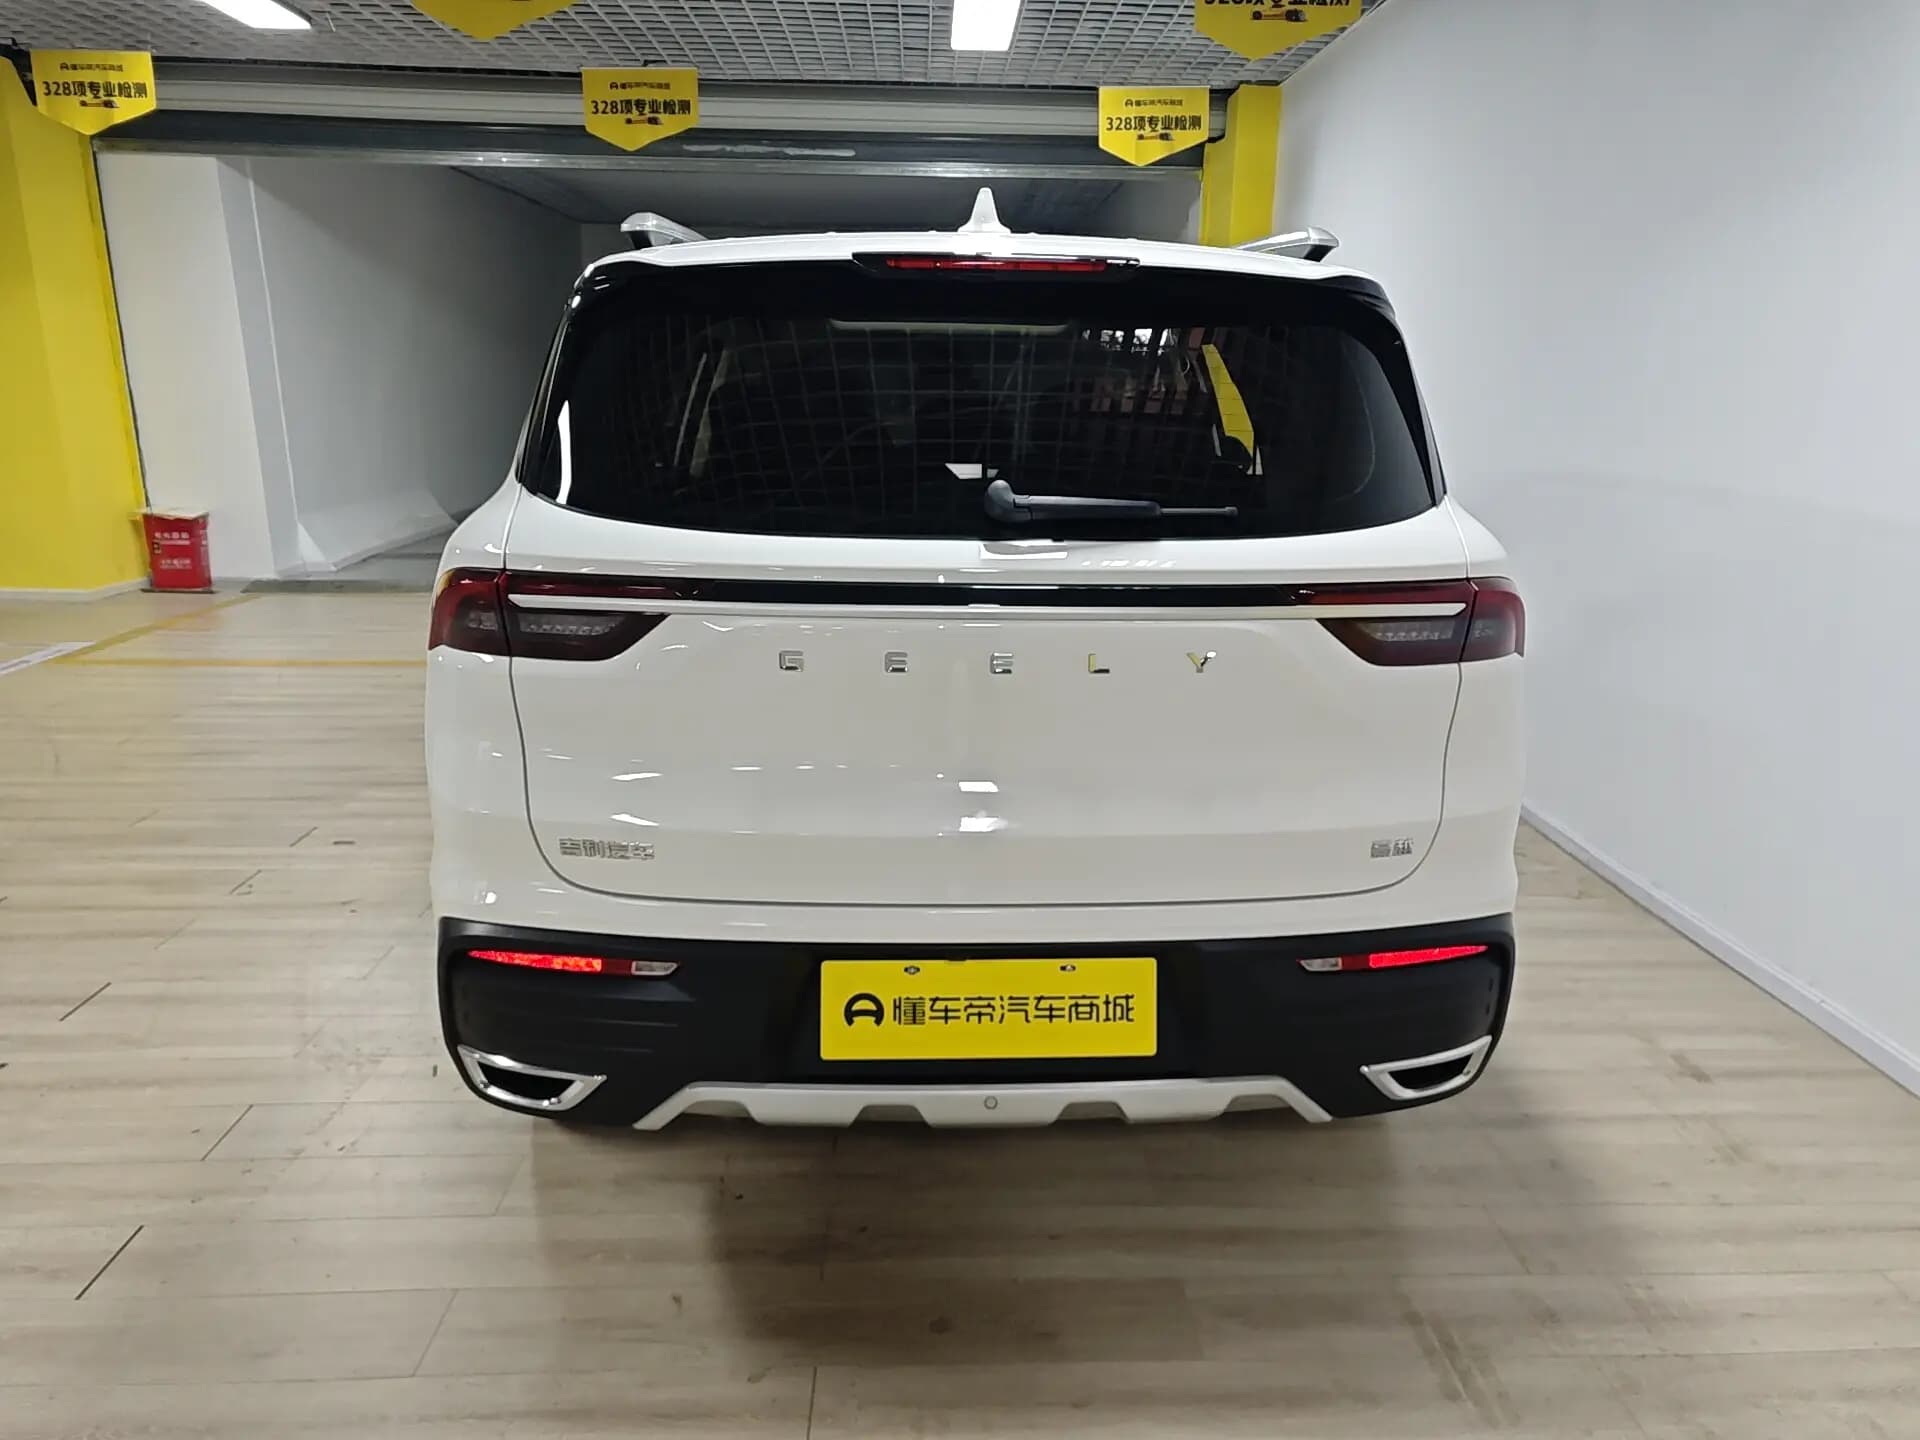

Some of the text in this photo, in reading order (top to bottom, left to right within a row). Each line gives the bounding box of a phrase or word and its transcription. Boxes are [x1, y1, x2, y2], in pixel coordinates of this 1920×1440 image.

[43, 81, 147, 99] 328项专业检测
[591, 99, 691, 116] 328项专业检测
[1106, 115, 1201, 132] 328项专业检测
[778, 650, 1217, 674] GEELY
[893, 994, 1136, 1026] 懂车帝汽车商城
